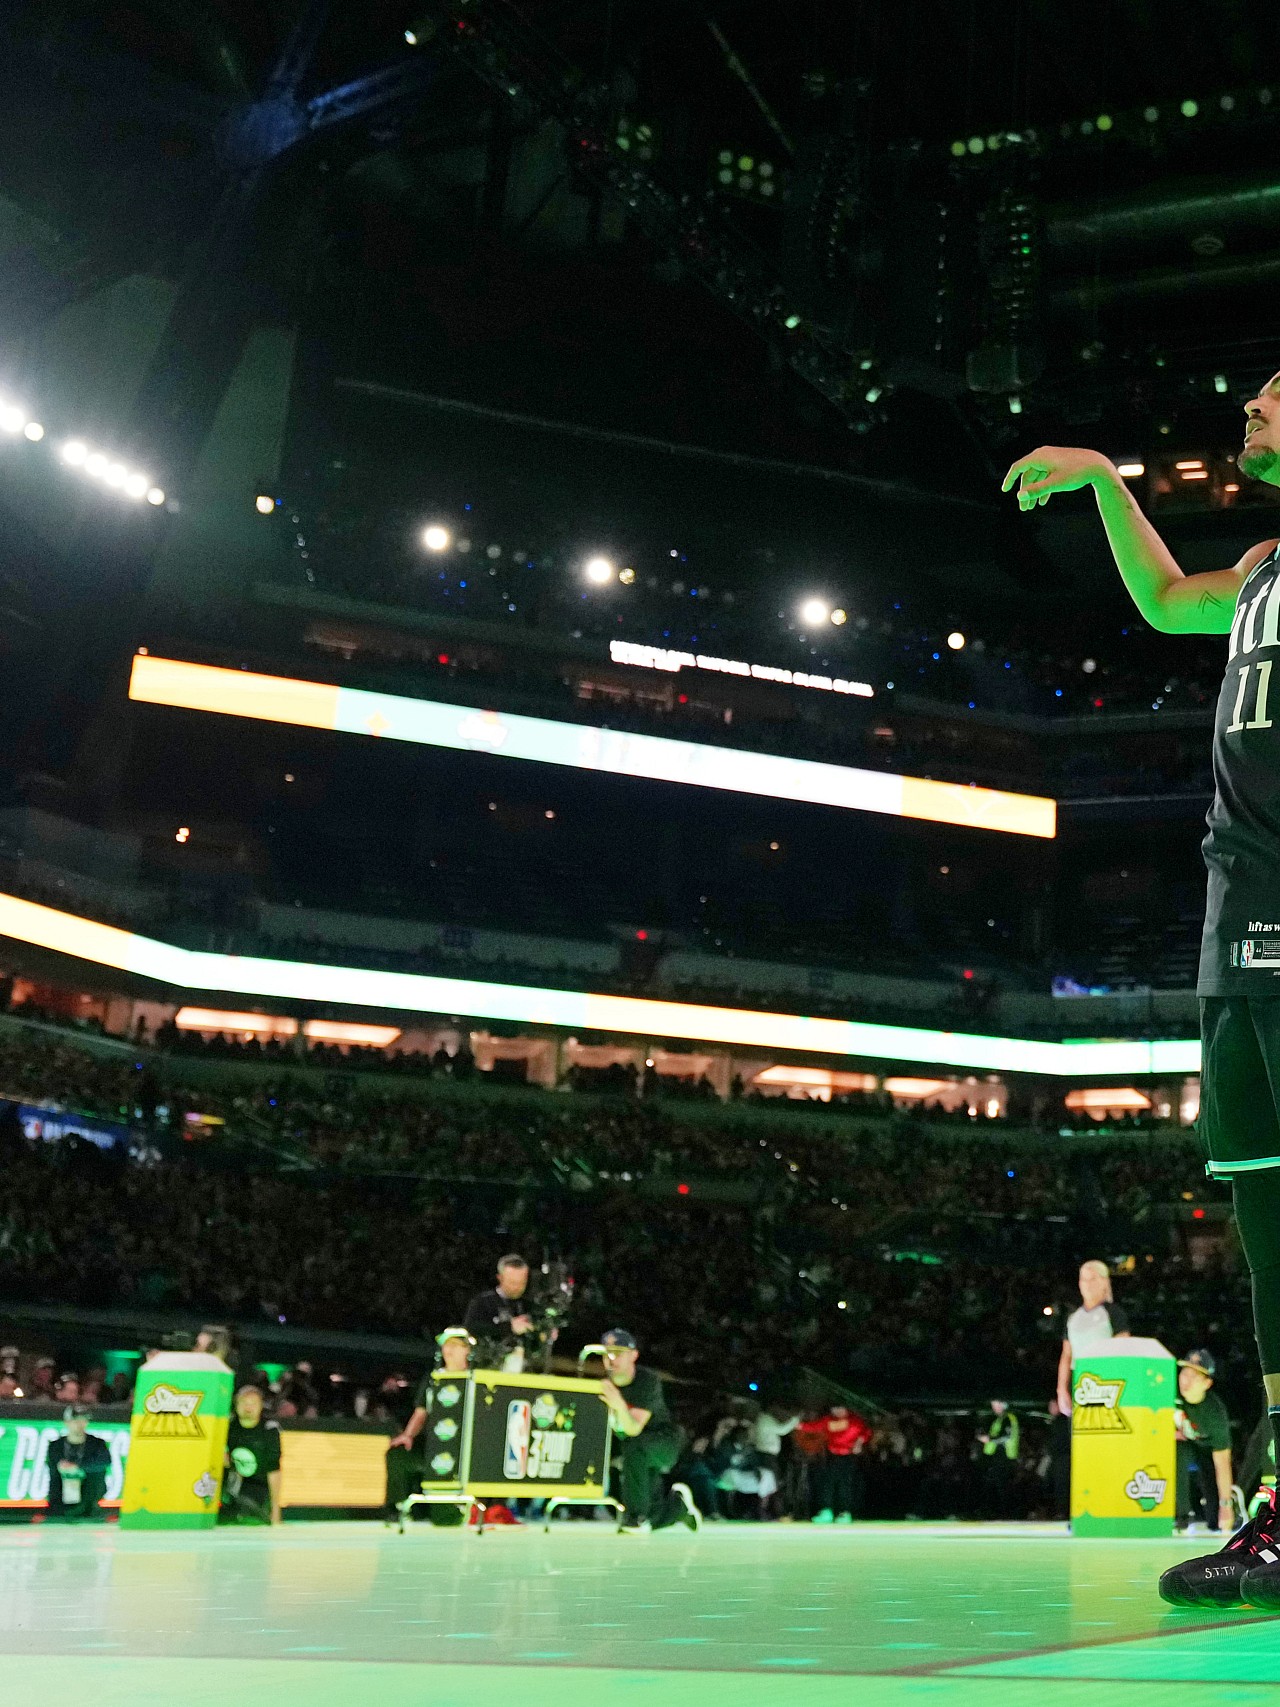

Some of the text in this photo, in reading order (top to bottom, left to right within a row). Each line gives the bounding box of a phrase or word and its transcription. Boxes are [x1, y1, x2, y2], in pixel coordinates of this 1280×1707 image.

[1227, 660, 1273, 734] 11
[1248, 921, 1262, 932] lift
[1263, 924, 1273, 932] as
